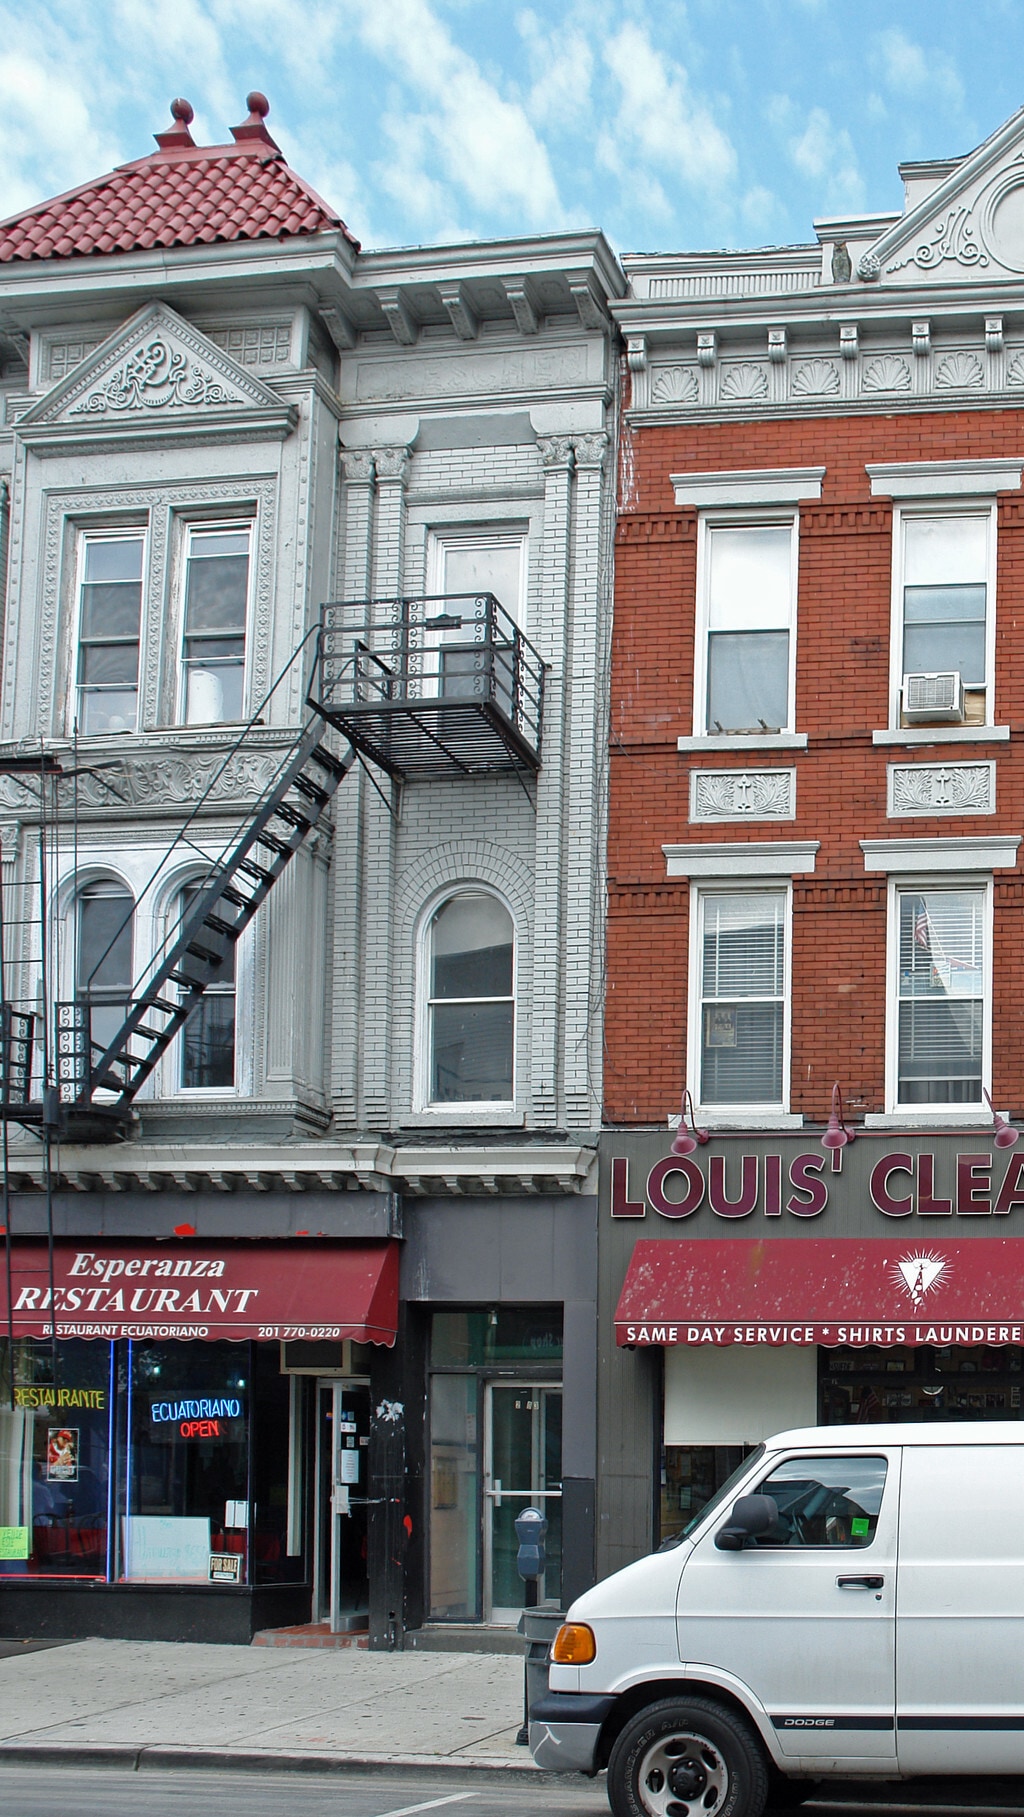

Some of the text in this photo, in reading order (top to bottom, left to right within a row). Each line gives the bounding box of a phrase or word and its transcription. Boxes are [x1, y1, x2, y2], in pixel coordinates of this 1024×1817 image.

[611, 1147, 843, 1218] LOUIS'
[67, 1253, 226, 1283] Esperanza
[13, 1287, 259, 1313] RESTAURANT
[121, 1325, 208, 1337] ECUATORIANO
[258, 1327, 340, 1337] 201 770-0220
[627, 1327, 678, 1342] SAME
[687, 1327, 726, 1342] DAY
[733, 1327, 814, 1342] SERVICE
[837, 1327, 906, 1342] SHIRTS
[13, 1388, 105, 1409] RESTAURANTE
[152, 1399, 241, 1422] ECUATORIANO
[180, 1420, 220, 1438] OPEN
[211, 1557, 238, 1573] FOR SALE
[784, 1718, 835, 1726] DODGE
